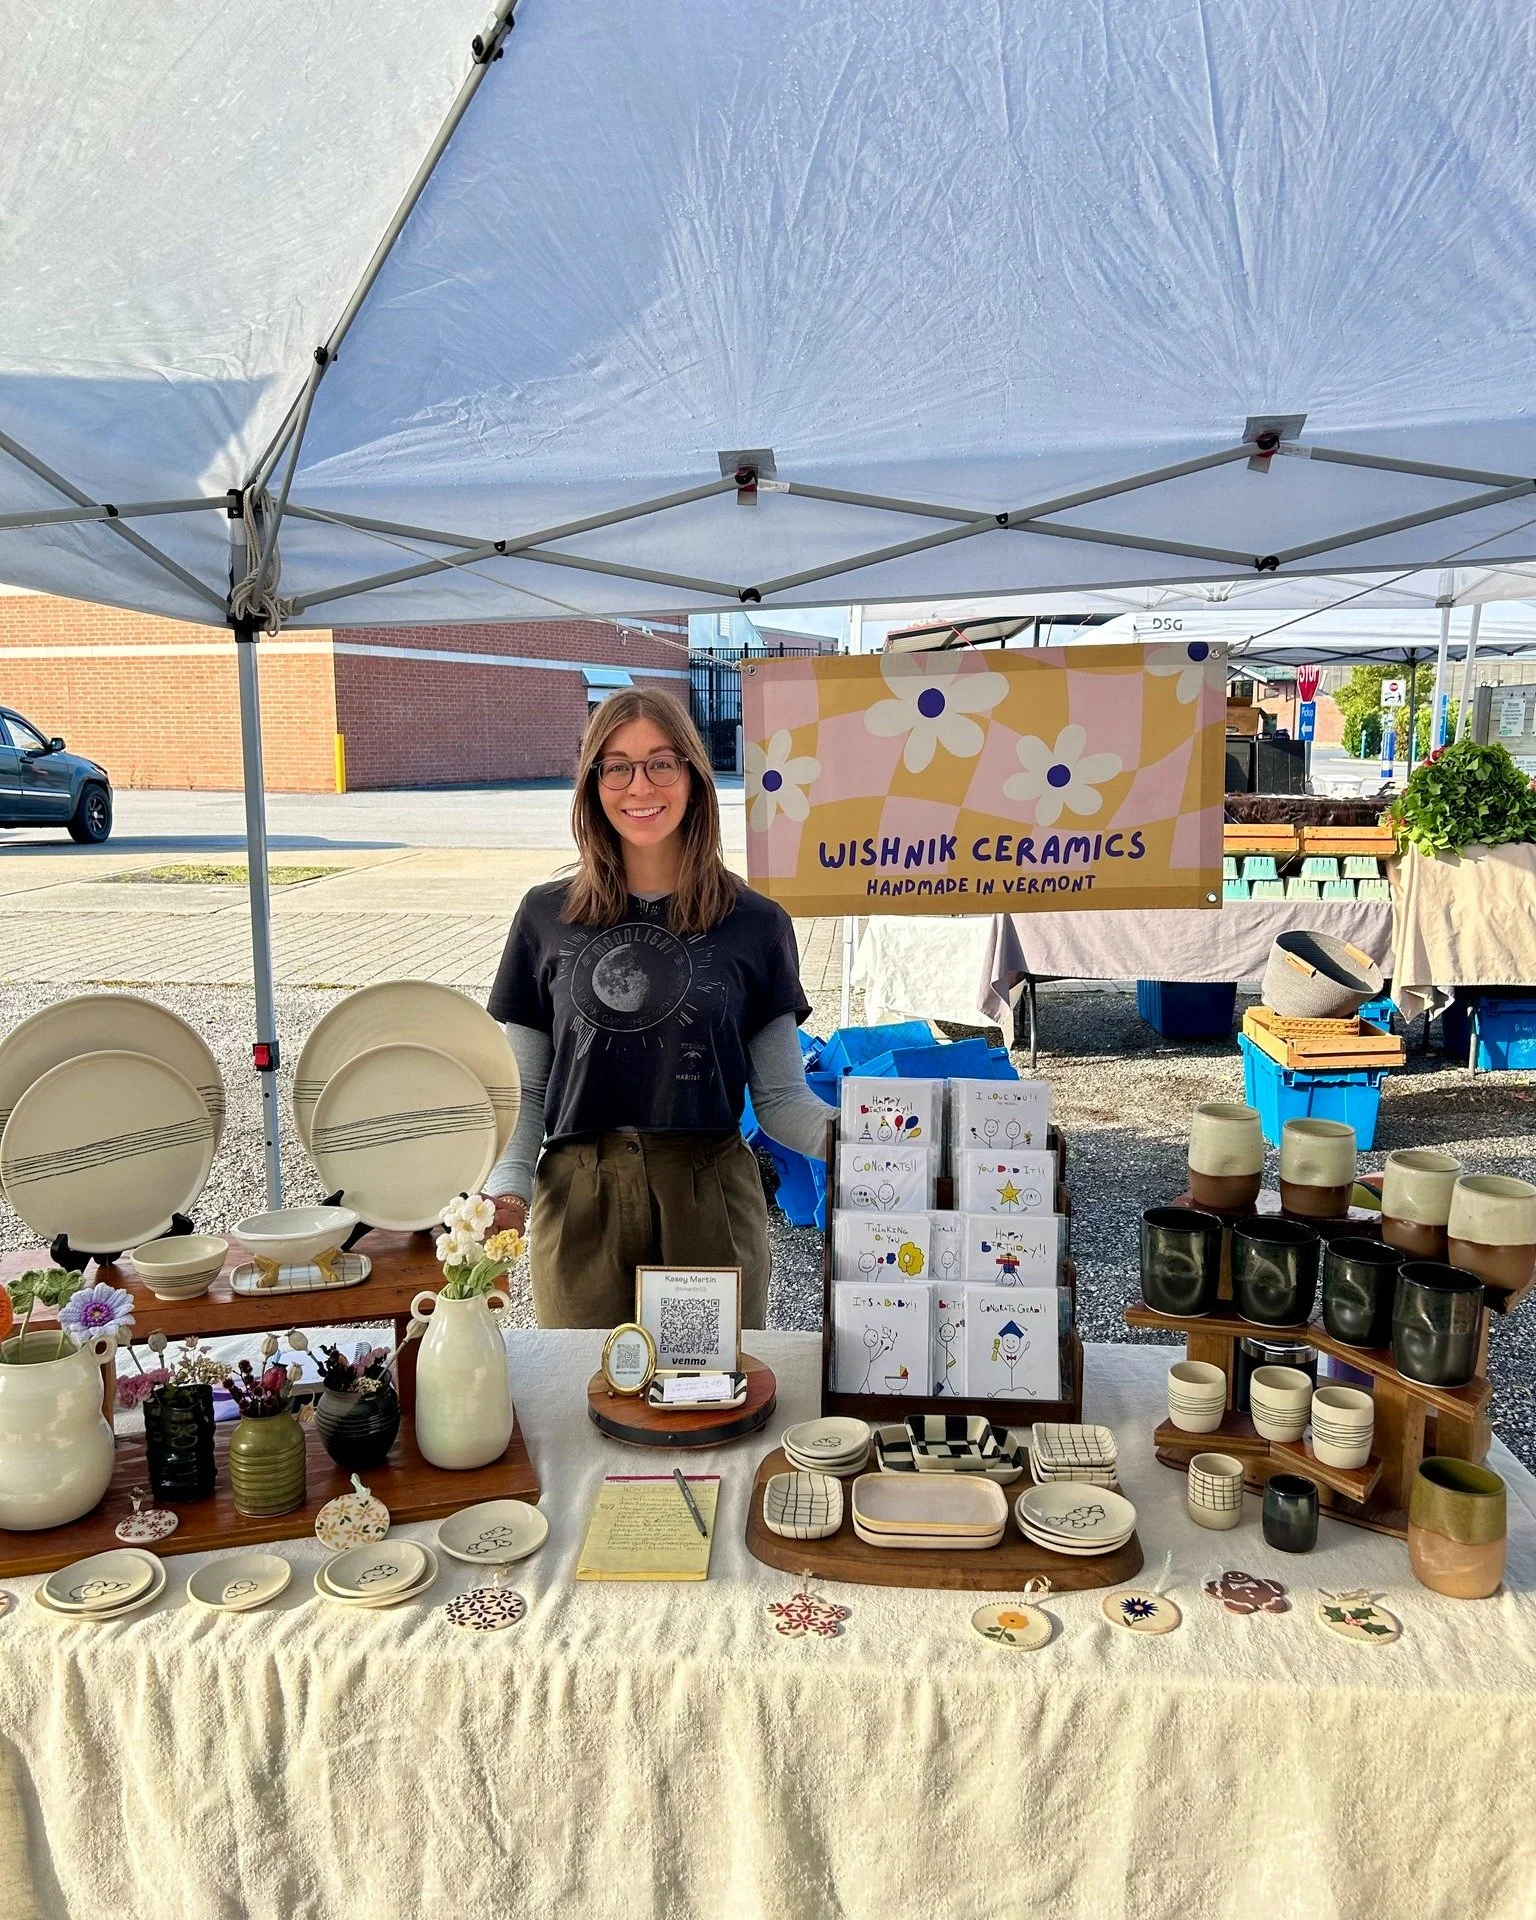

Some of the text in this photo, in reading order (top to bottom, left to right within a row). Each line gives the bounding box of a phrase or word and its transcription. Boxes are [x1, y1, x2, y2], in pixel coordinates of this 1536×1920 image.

[1153, 617, 1183, 631] DSG
[819, 830, 1146, 869] WISHNIK CERAMICS
[866, 874, 1096, 897] HANDMADE IN VERMONT
[591, 927, 677, 957] MOONLIGHT
[976, 1091, 983, 1101] I
[997, 1164, 1020, 1174] DID
[864, 1222, 908, 1235] THINKING
[886, 1234, 900, 1244] YOU
[664, 1274, 717, 1284] Kasey Martin
[671, 1357, 707, 1366] venmo
